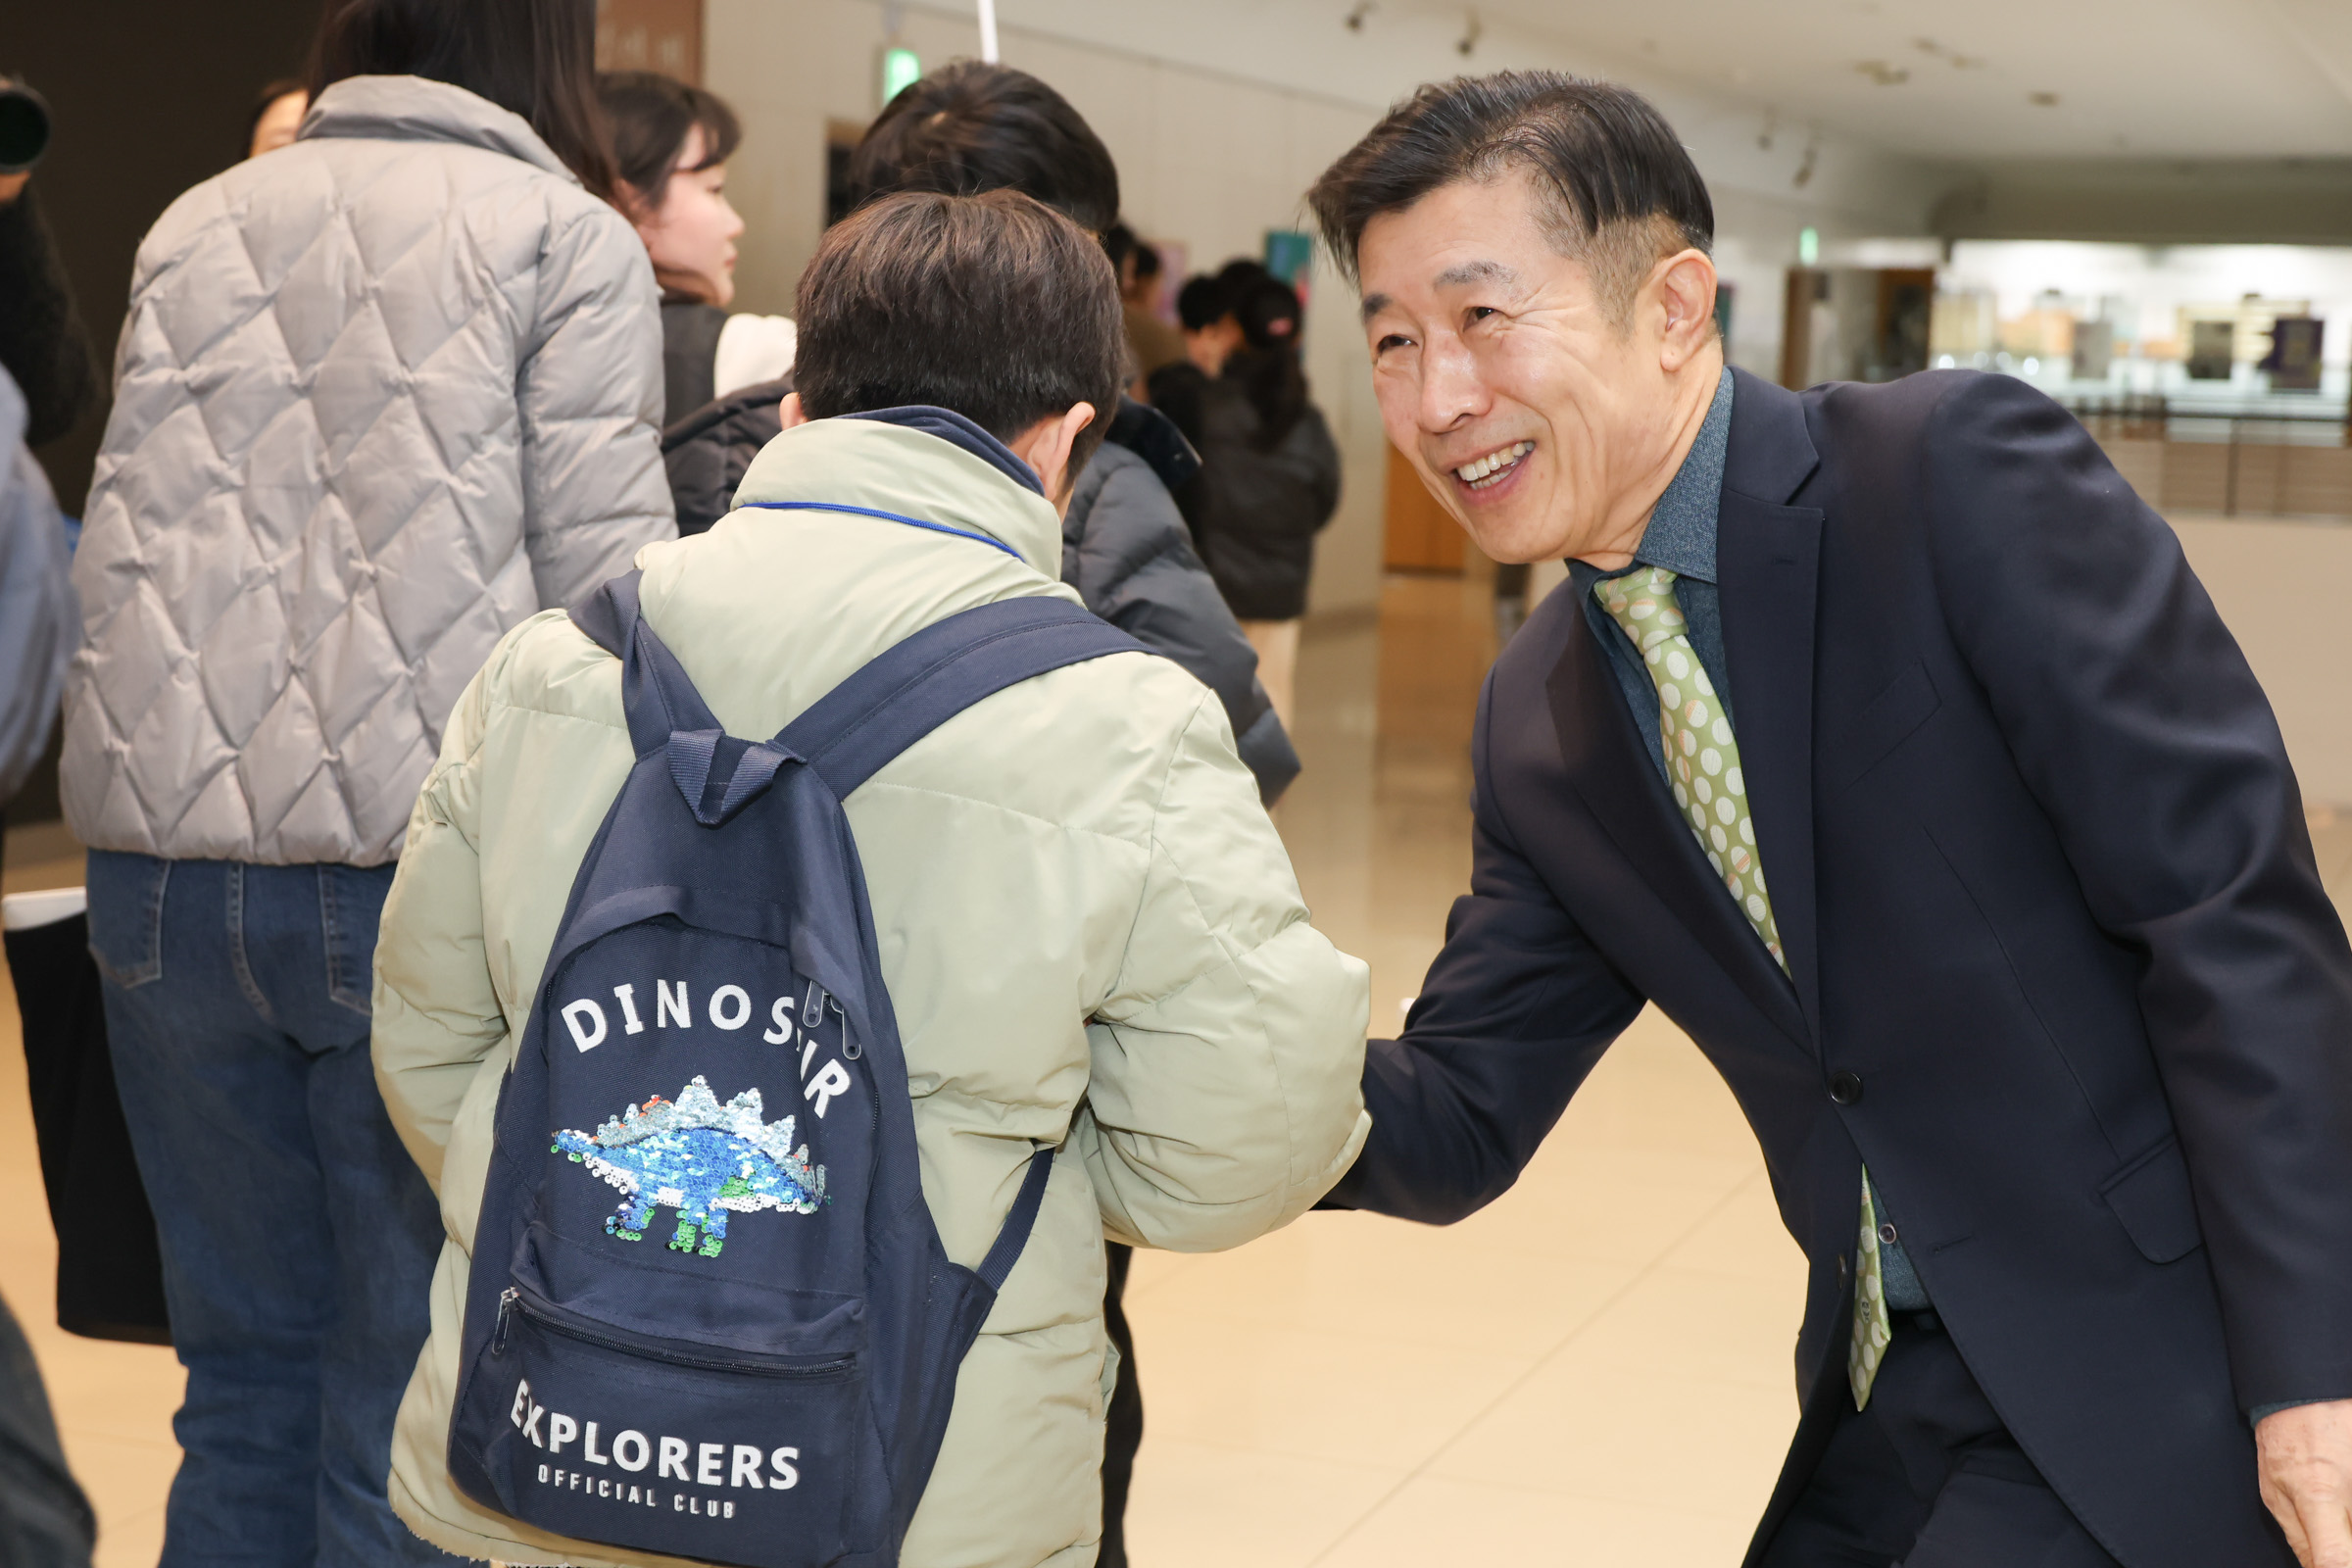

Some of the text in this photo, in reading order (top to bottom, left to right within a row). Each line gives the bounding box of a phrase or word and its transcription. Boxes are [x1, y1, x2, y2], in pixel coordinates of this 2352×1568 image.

[561, 979, 851, 1119] DINOSR
[511, 1378, 800, 1490] EXPLORERS
[538, 1464, 736, 1519] OFFICIAL CLUB
